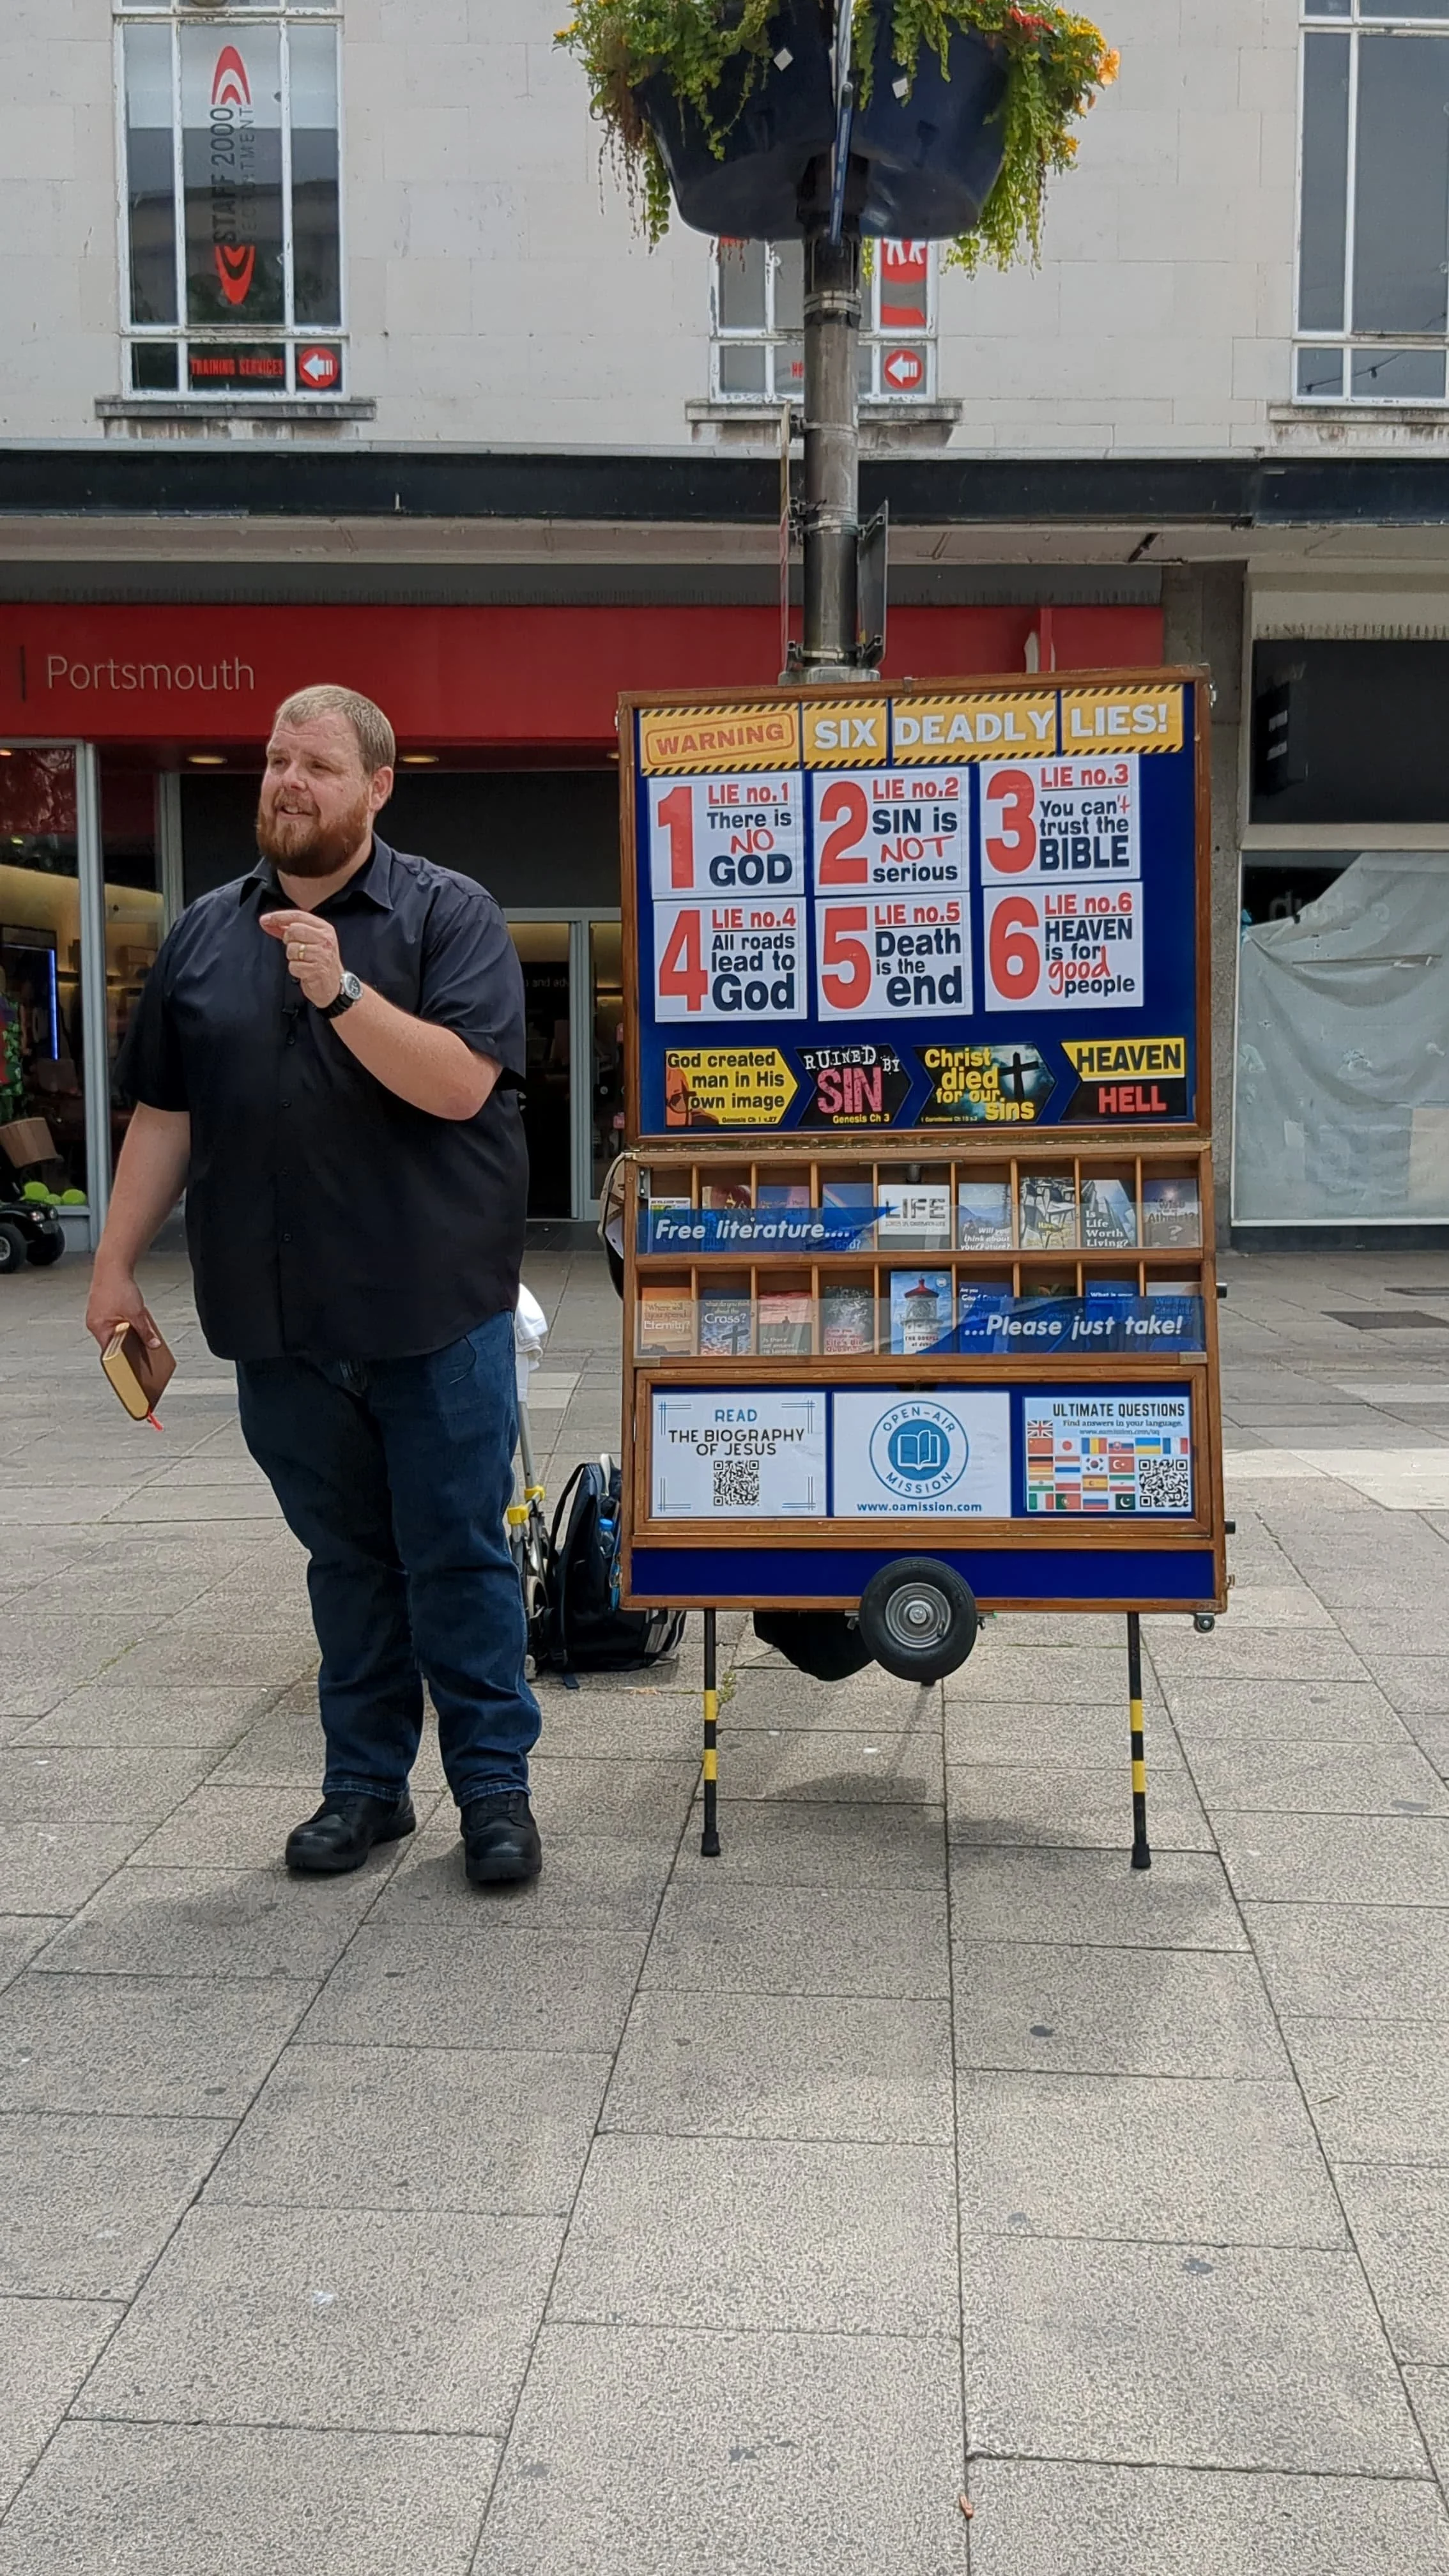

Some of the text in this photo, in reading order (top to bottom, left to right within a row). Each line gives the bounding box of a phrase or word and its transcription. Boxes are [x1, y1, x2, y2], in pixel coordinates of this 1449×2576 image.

[210, 107, 236, 243] STAFF 2000
[190, 358, 284, 376] TRAINING SERVICES
[47, 656, 255, 690] Portsmouth
[815, 704, 1168, 749] SIX DEADLY LIES!
[656, 723, 785, 756] WARNING
[1040, 763, 1129, 788] LIE no.3
[709, 782, 788, 805] LIE no.1
[873, 777, 958, 801] LIE no.2
[1039, 794, 1130, 817] You can't
[707, 809, 792, 829] There is
[872, 807, 958, 836] SIN is
[986, 769, 1037, 874] 3
[1039, 816, 1129, 836] trust the
[657, 786, 694, 889] 1
[731, 829, 774, 854] NO
[819, 781, 869, 885] 2
[880, 835, 955, 864] NOT
[1039, 835, 1130, 871] BIBLE
[709, 854, 793, 887] GOD
[873, 862, 958, 883] serious
[875, 902, 960, 925] LIE no.5
[1045, 893, 1132, 915] LIE no.6
[712, 907, 796, 928] LIE no.4
[1045, 918, 1132, 942] HEAVEN
[712, 933, 795, 951] All roads
[875, 928, 961, 958] Death
[989, 896, 1040, 1000] 6
[1045, 943, 1101, 961] is for
[659, 910, 708, 1012] 4
[712, 951, 795, 972] lead to
[822, 907, 871, 1009] 5
[876, 958, 925, 975] is the
[1048, 944, 1110, 995] good
[712, 972, 795, 1011] God
[886, 965, 963, 1008] end
[1064, 976, 1135, 997] people
[668, 1051, 776, 1068] God created
[804, 1046, 901, 1075] RUINED BY
[924, 1047, 992, 1068] Christ
[1077, 1044, 1181, 1073] HEAVEN
[692, 1071, 785, 1088] man in His
[942, 1065, 999, 1090] died
[691, 1093, 785, 1110] own image
[817, 1066, 883, 1114] SIN
[935, 1087, 1000, 1103] for our
[1099, 1086, 1167, 1114] HELL
[833, 1114, 889, 1124] Genesis Ch 3
[985, 1096, 1034, 1121] sins
[885, 1198, 946, 1219] LIFE
[656, 1219, 706, 1239] Free
[1086, 1220, 1108, 1228] Life
[1086, 1229, 1124, 1238] Worth
[963, 1234, 985, 1243] think
[1086, 1239, 1129, 1248] Living?
[644, 1321, 691, 1333] Eternity?
[705, 1313, 747, 1323] Cross?
[1071, 1316, 1115, 1340] just
[1125, 1315, 1183, 1335] take!
[715, 1409, 758, 1422] READ
[883, 1406, 956, 1433] OPEN-AIR
[1053, 1402, 1185, 1418] ULTIMATE QUESTIONS
[1145, 1419, 1183, 1428] language.
[668, 1429, 804, 1443] THE BIOGRAPHY
[696, 1443, 777, 1456] OF JESUS
[885, 1472, 953, 1494] MISSION
[857, 1502, 982, 1512] www.oamission.com
